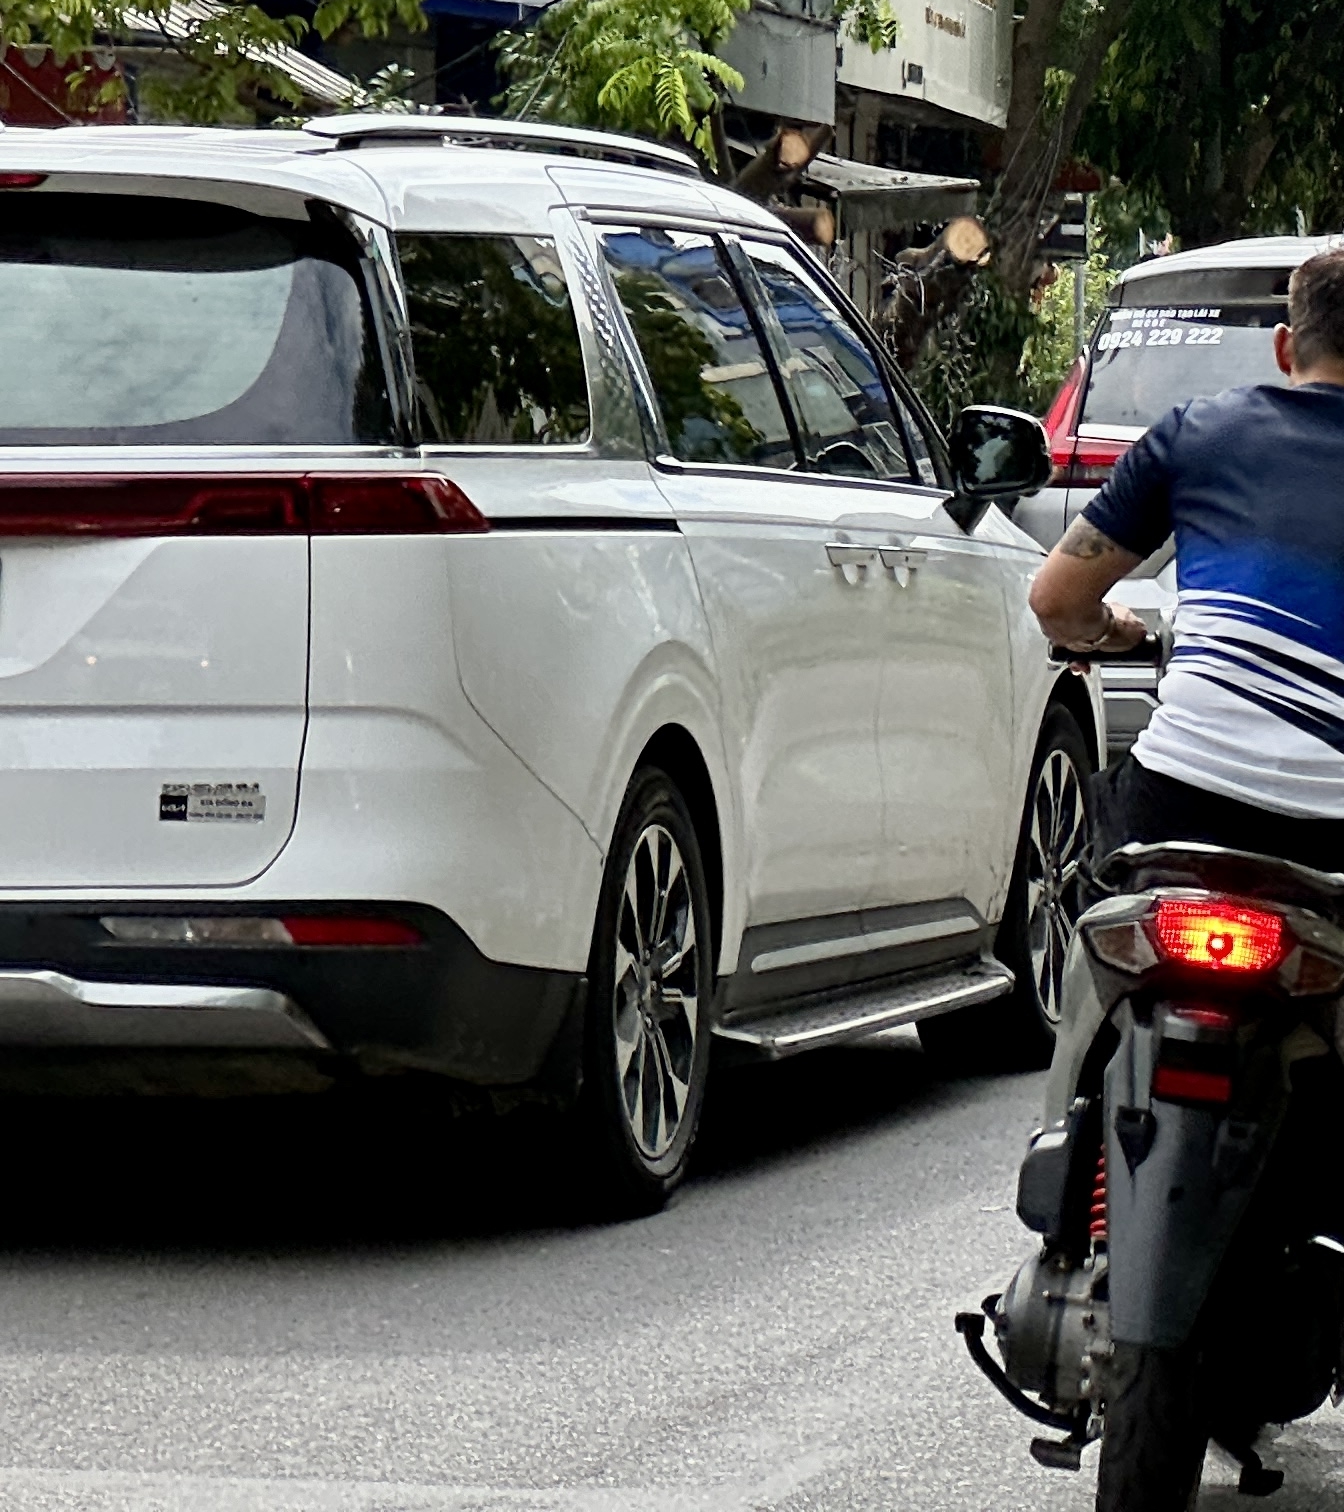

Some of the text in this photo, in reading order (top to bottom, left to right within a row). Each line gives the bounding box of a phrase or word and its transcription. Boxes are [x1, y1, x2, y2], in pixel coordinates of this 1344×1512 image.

[1098, 328, 1223, 350] 0924 229 222
